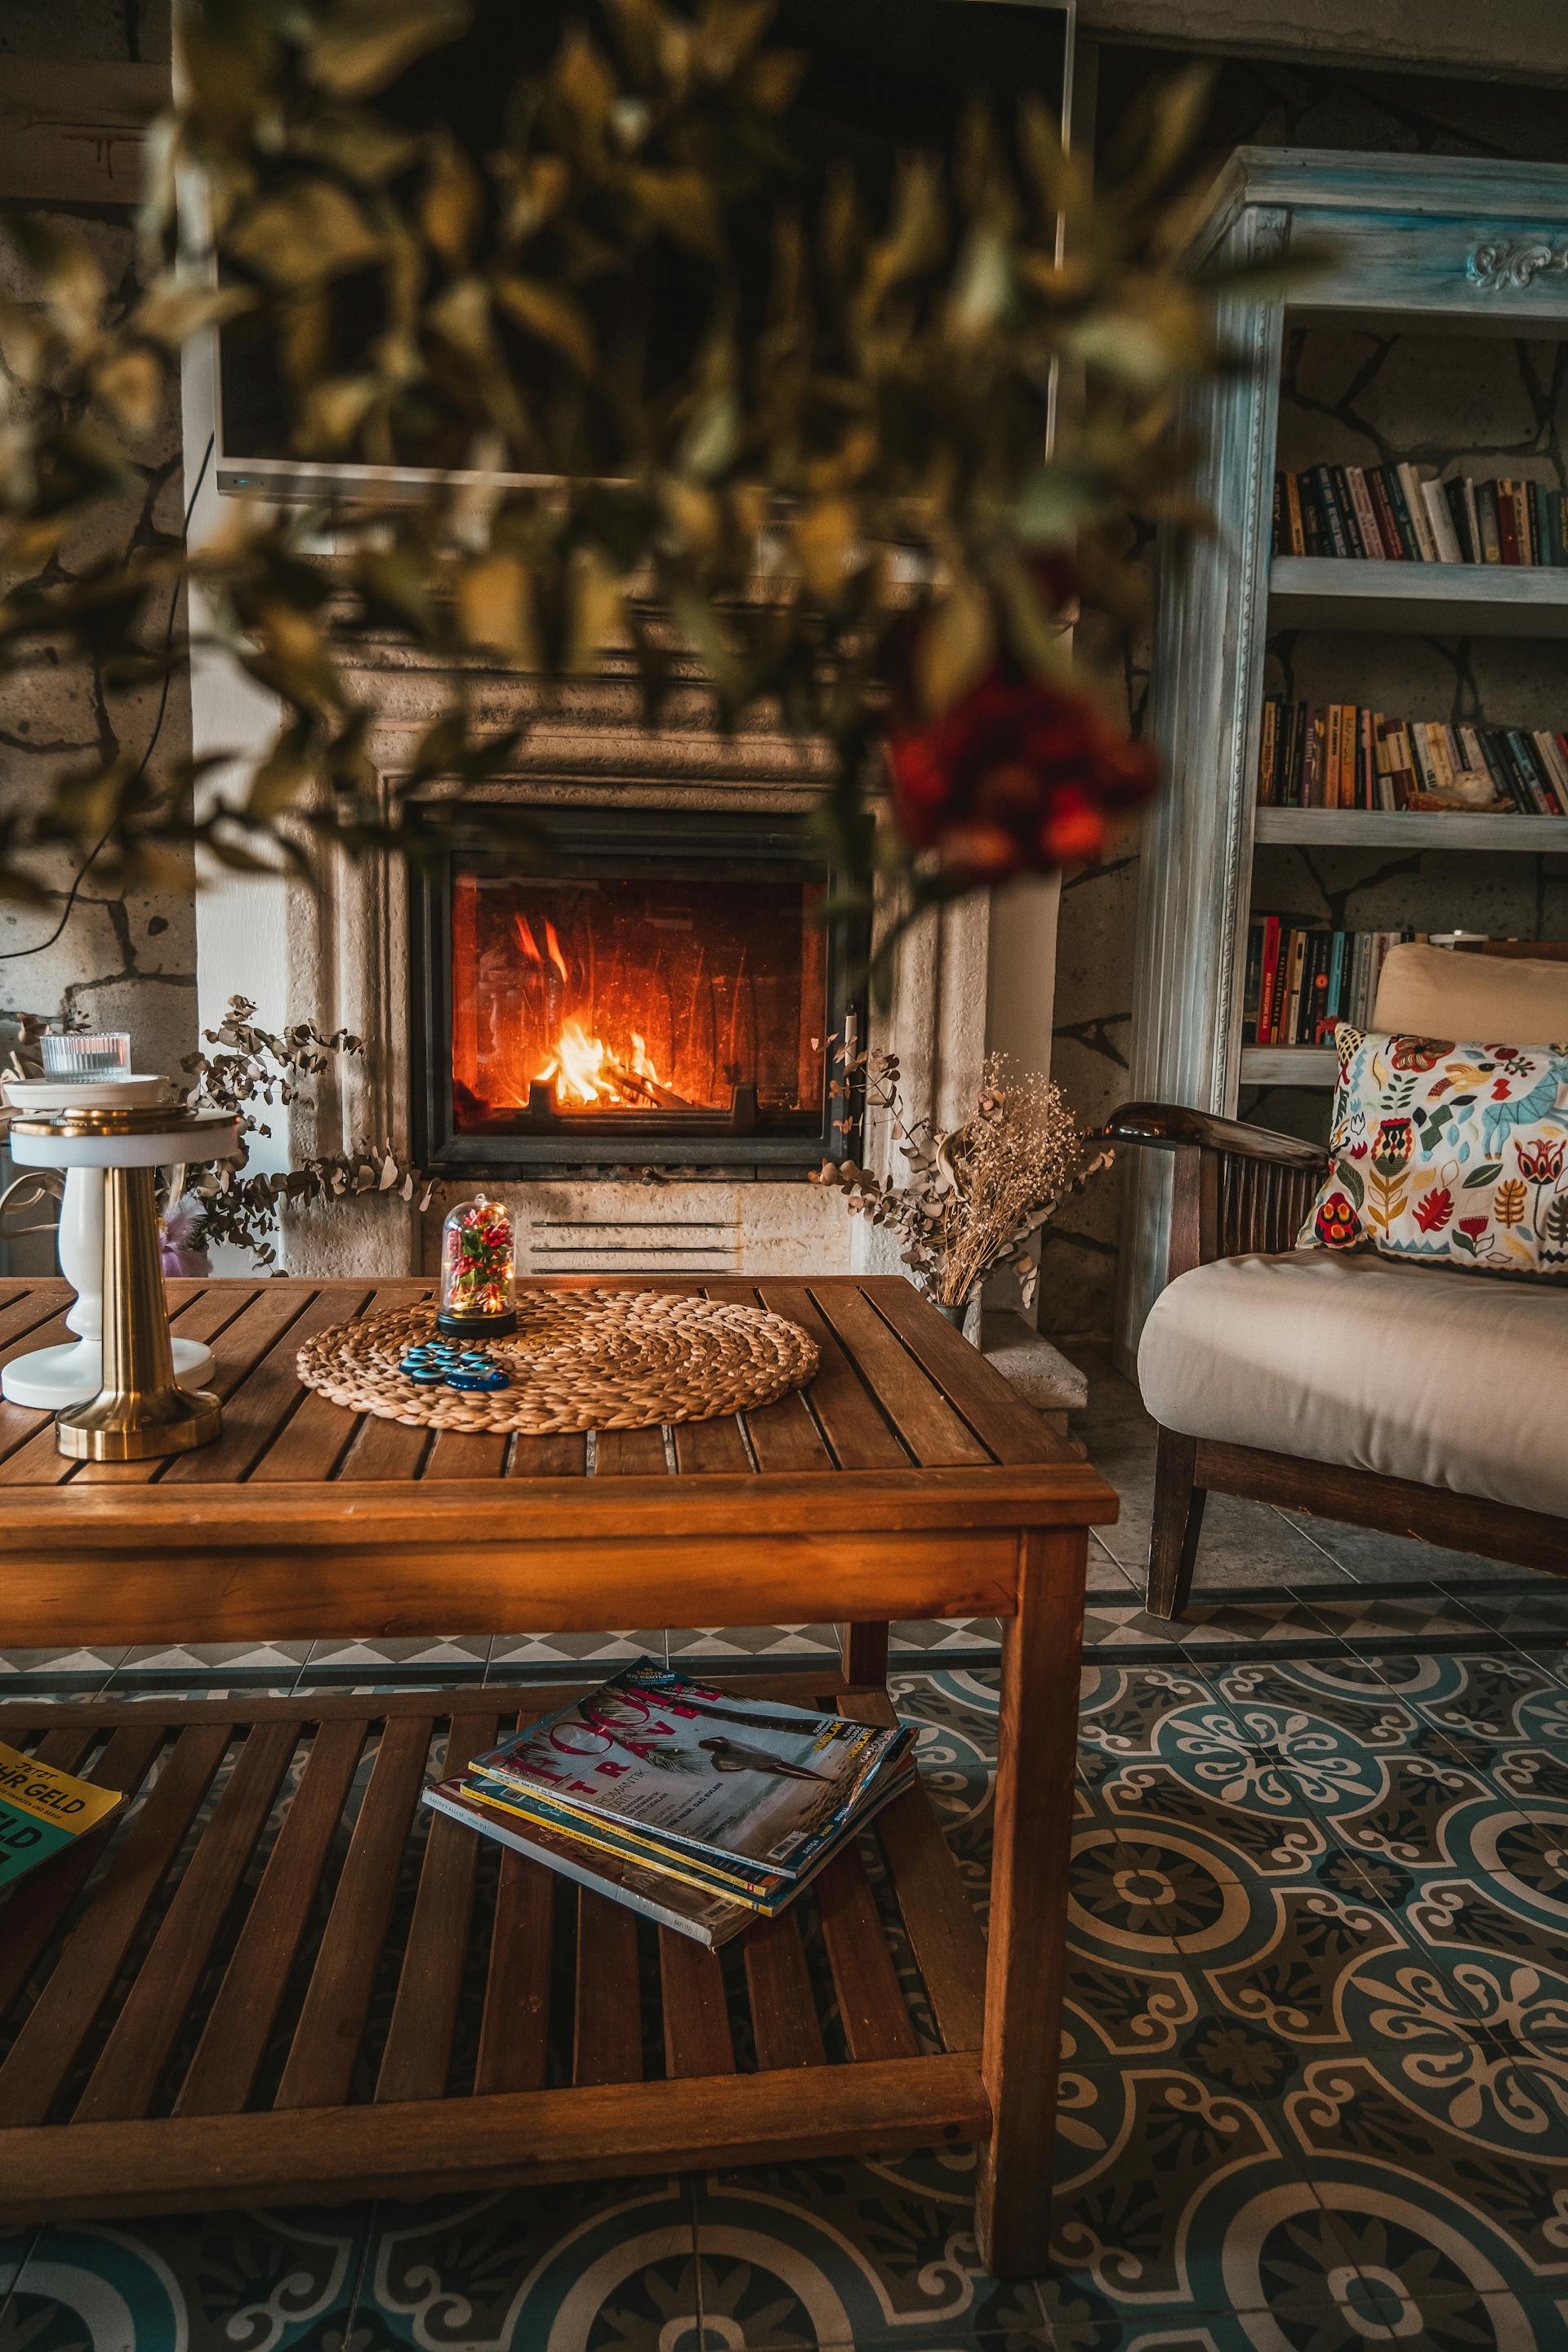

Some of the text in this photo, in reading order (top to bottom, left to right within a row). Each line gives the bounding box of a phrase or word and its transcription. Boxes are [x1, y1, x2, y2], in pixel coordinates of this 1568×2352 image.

[567, 1690, 724, 1794] TRAVEL
[811, 1721, 845, 1751] MASLAK
[15, 1762, 59, 1780] JETZT
[24, 1784, 85, 1814] GELD
